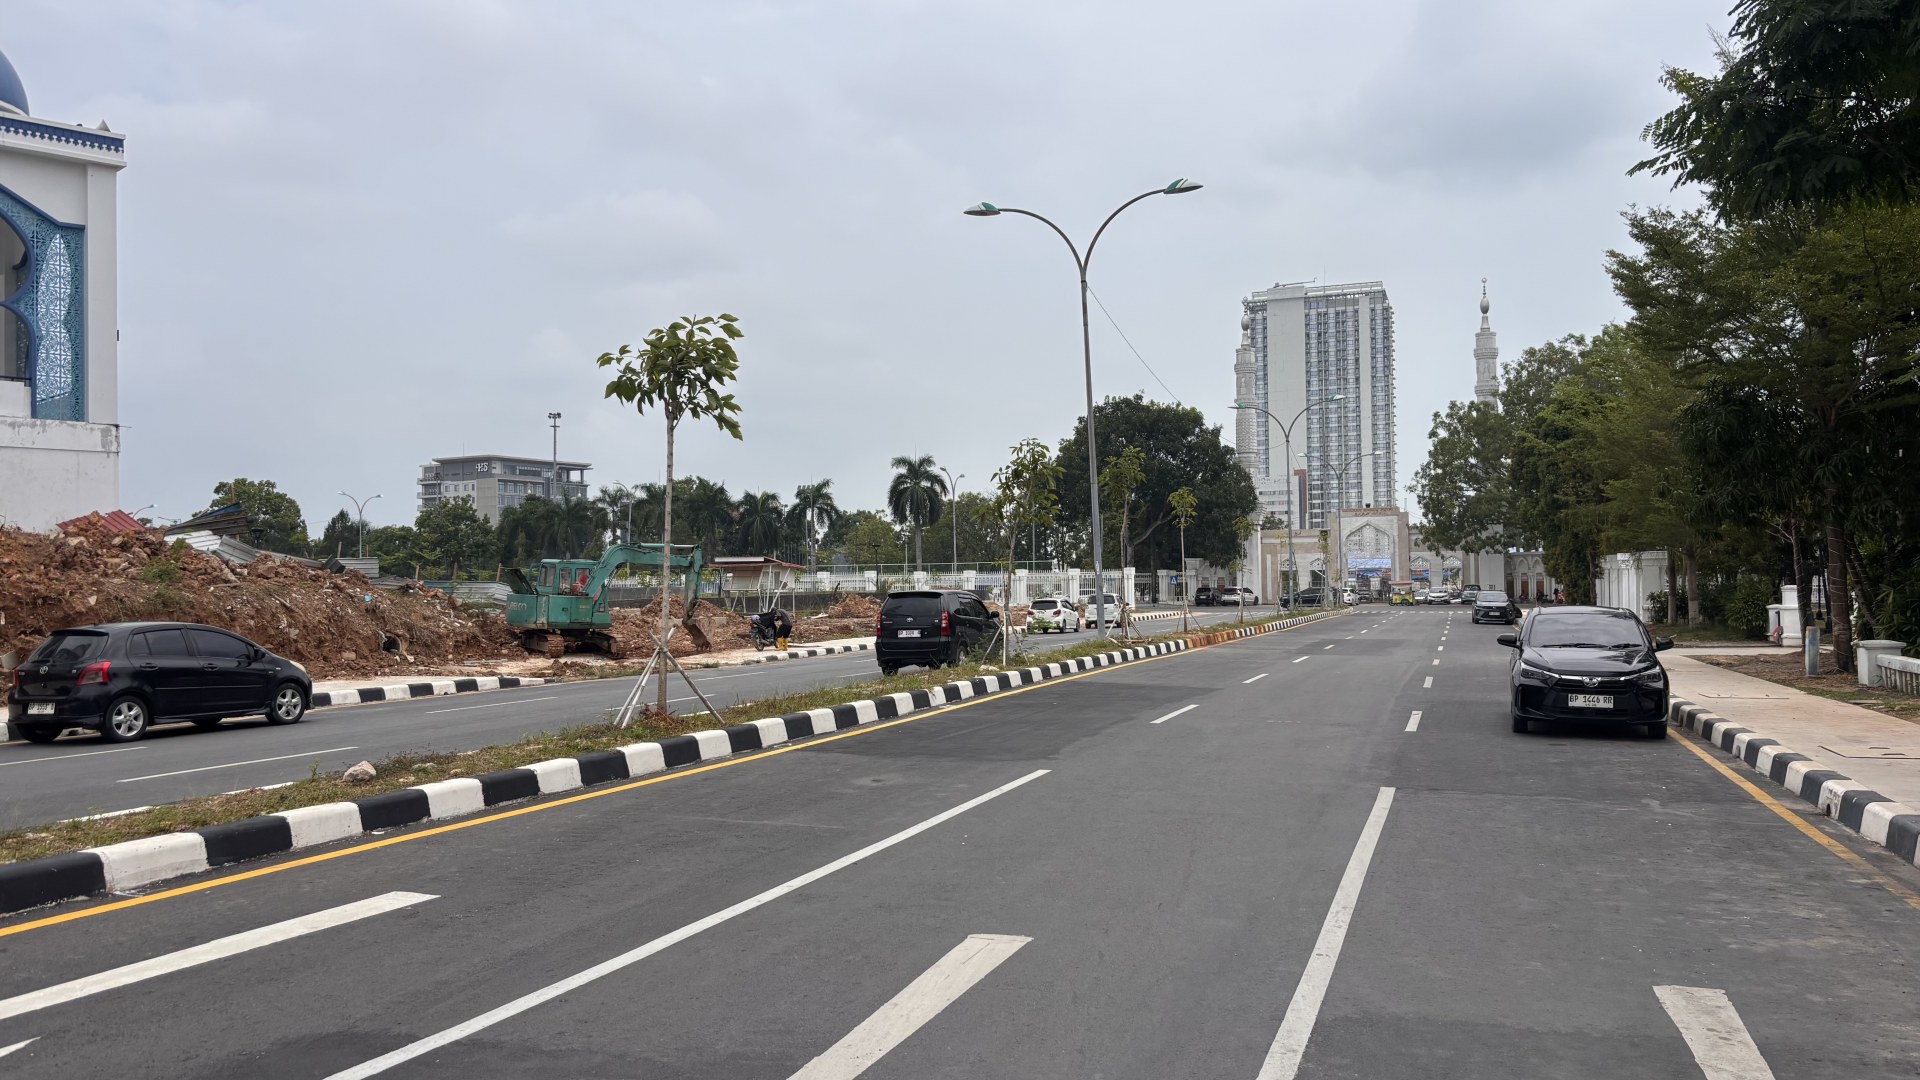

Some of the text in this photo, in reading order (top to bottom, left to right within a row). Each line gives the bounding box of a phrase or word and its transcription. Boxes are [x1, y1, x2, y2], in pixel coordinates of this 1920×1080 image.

[1569, 694, 1579, 703] BP
[1582, 695, 1601, 704] 1446
[1603, 696, 1613, 705] RR
